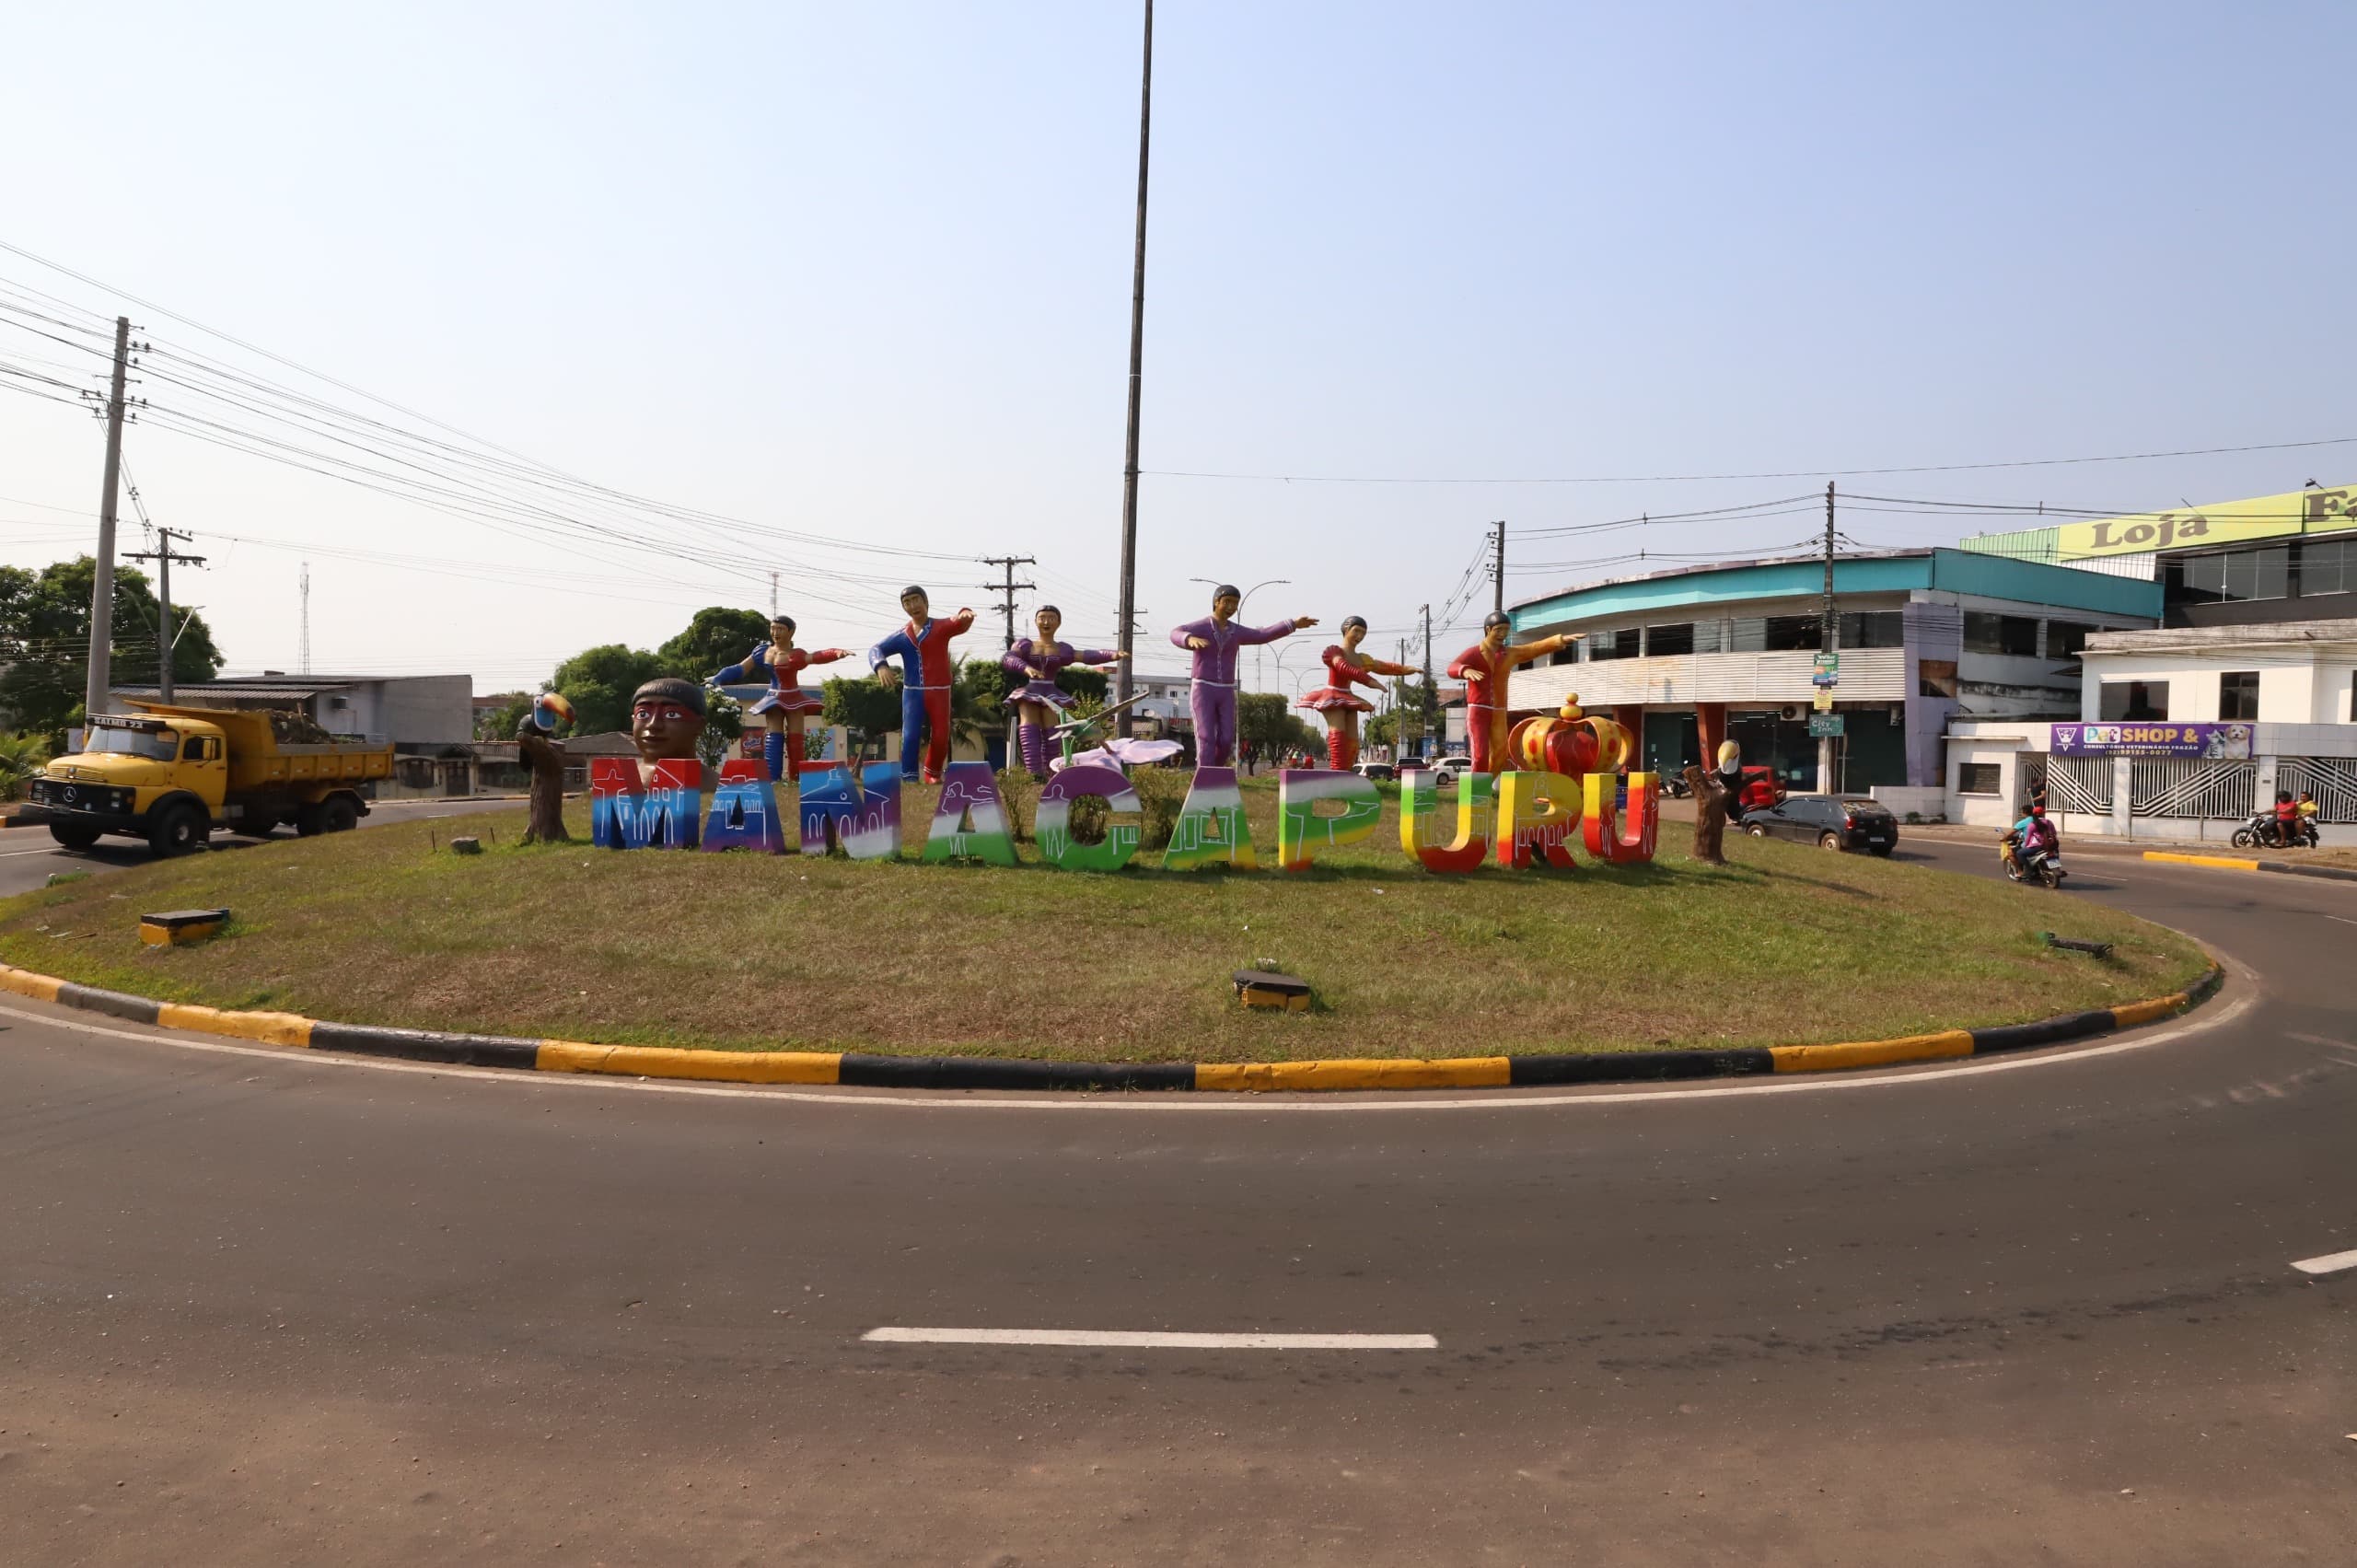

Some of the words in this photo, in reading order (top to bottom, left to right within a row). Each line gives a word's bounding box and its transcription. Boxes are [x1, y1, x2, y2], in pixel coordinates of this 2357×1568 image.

[2091, 514, 2210, 549] Loja
[2086, 727, 2118, 742] Pet
[2121, 727, 2178, 743] SHOP
[2183, 728, 2199, 743] &
[591, 757, 1661, 873] MANACAPURU
